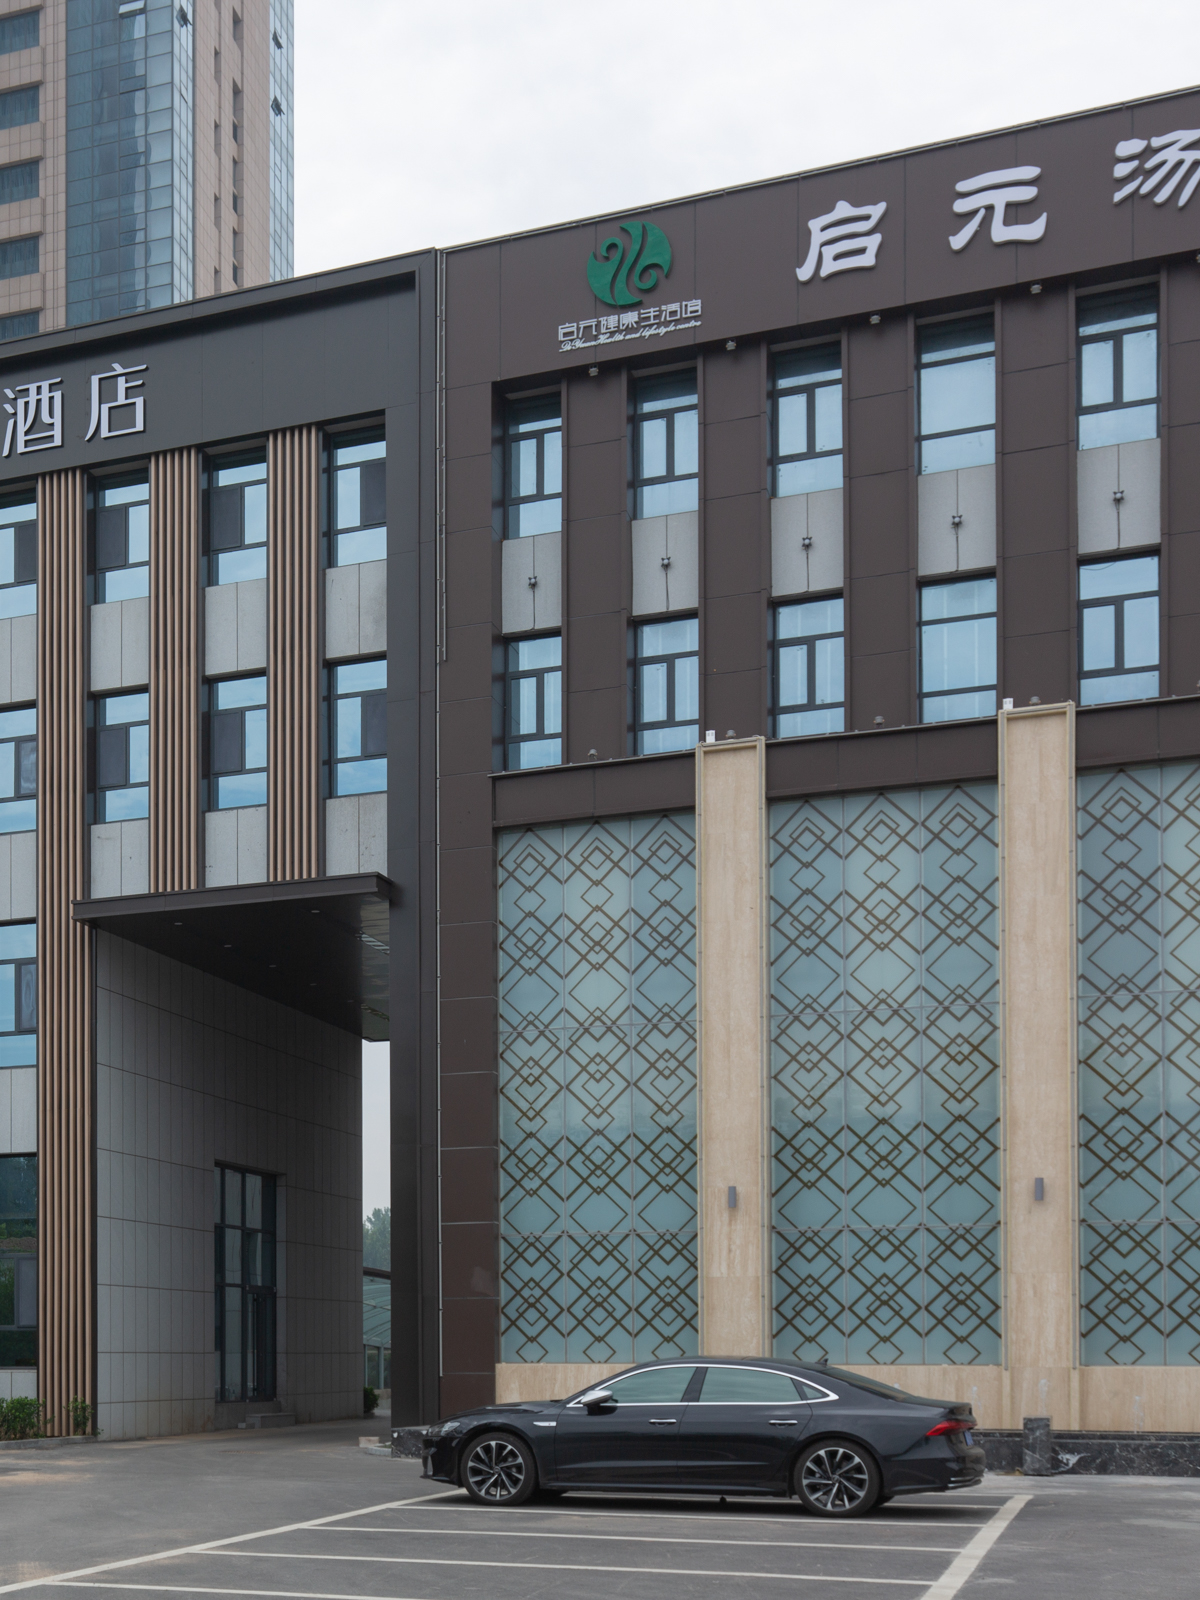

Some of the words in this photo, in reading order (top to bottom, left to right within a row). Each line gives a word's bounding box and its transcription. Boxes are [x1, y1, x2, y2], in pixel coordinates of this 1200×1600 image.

[795, 128, 1200, 284] 启元汤
[558, 299, 702, 341] 启元健康生活馆
